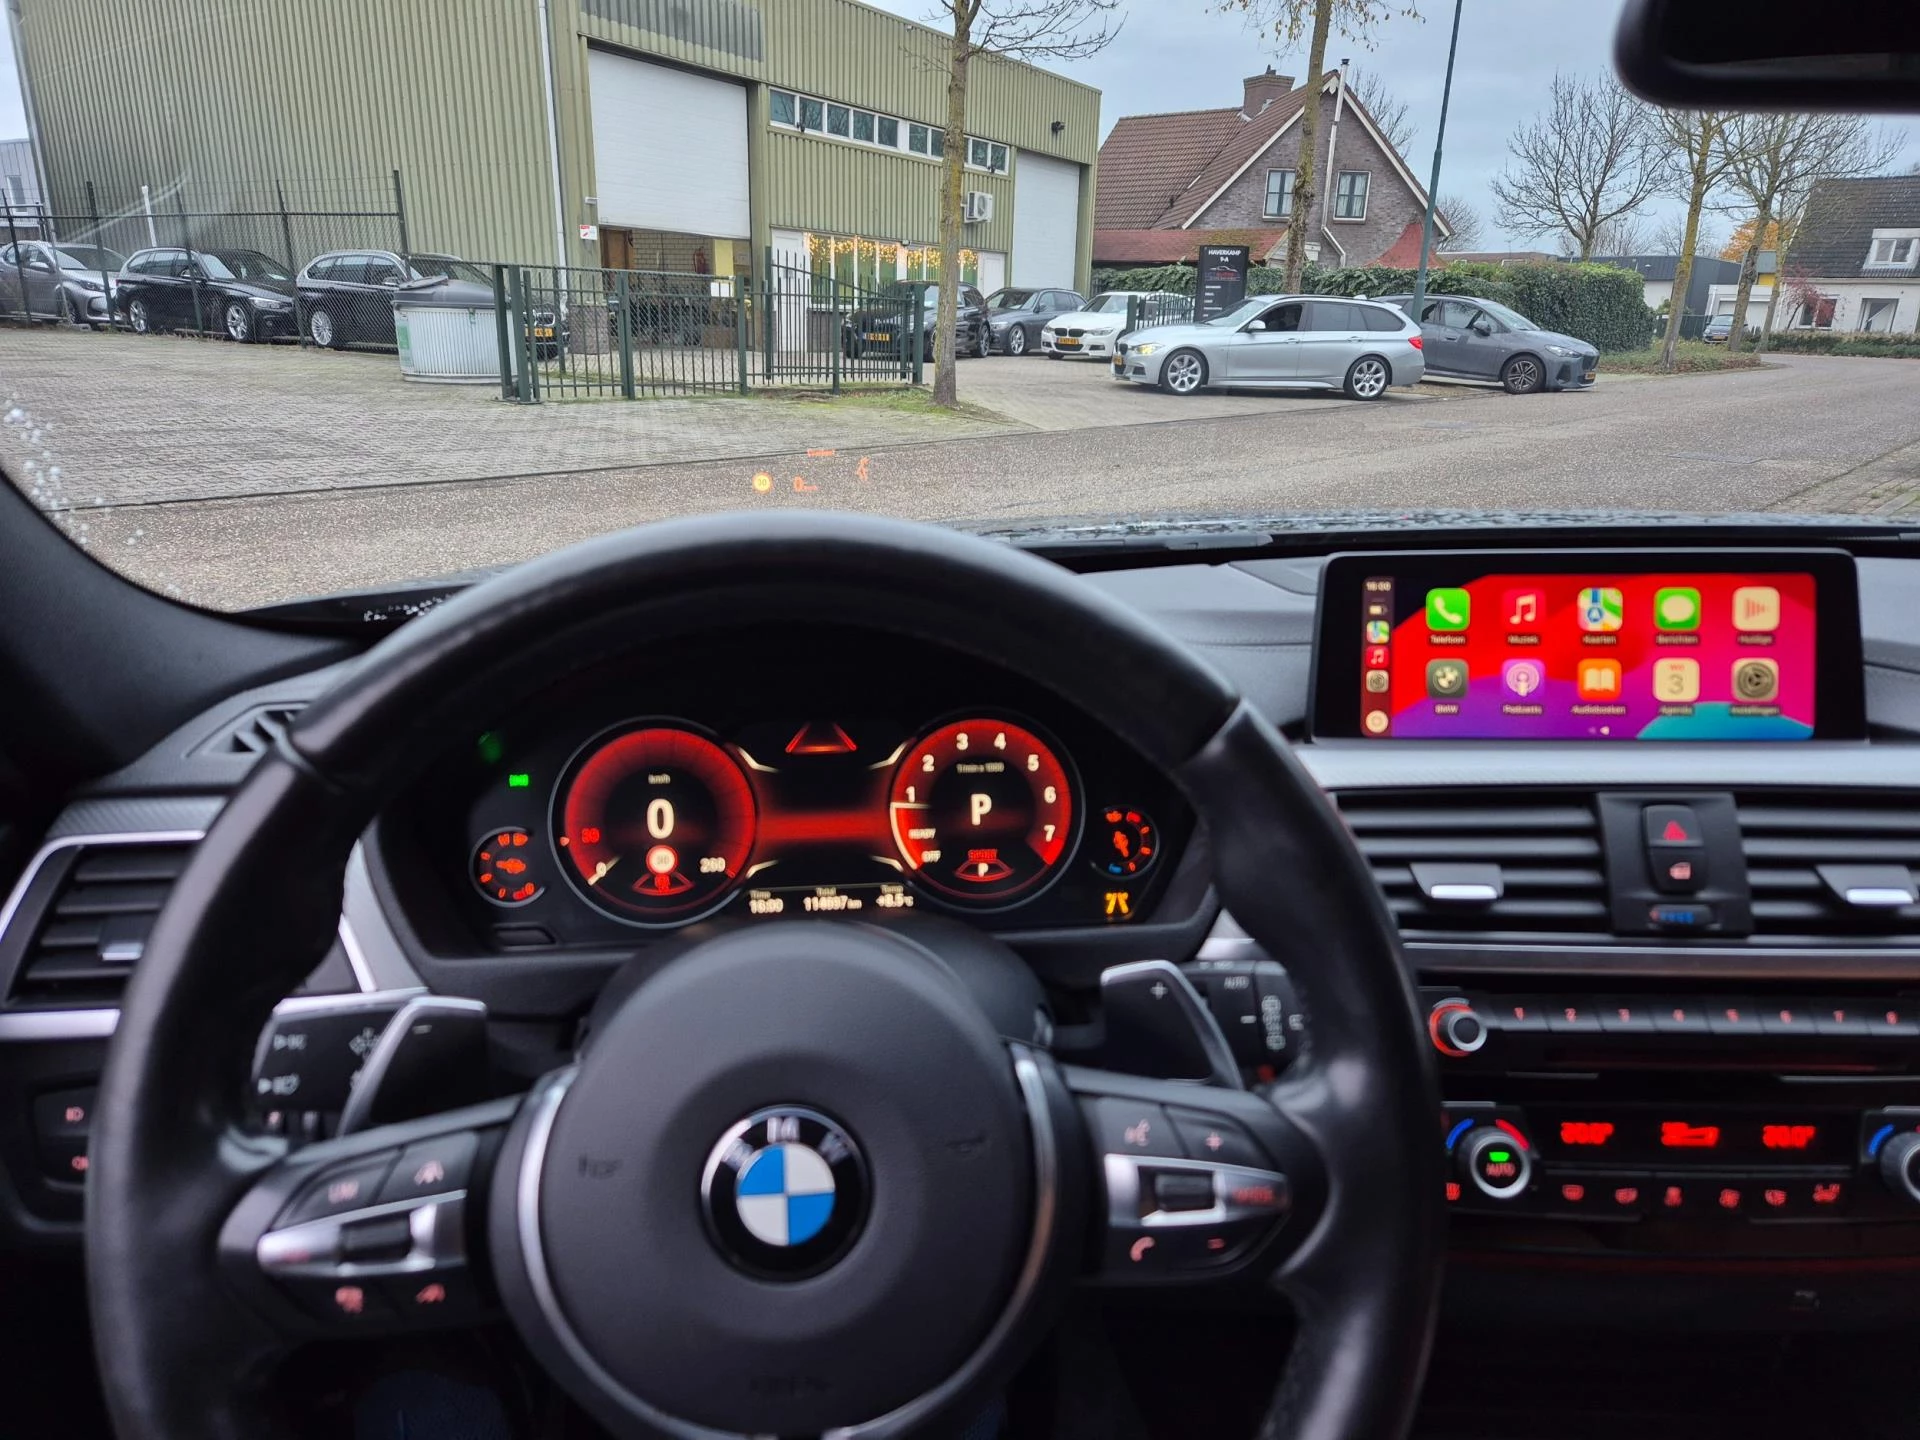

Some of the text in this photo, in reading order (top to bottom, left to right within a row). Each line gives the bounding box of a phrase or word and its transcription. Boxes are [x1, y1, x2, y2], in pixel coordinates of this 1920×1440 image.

[1429, 634, 1466, 645] Telefoon
[1507, 634, 1540, 645] Muziek
[1582, 634, 1617, 645] Kaarten
[1656, 634, 1698, 646] Berichten
[1668, 673, 1685, 695] 3
[1434, 704, 1459, 715] BMW
[1502, 704, 1542, 716] Podcasts
[956, 732, 968, 750] 3
[994, 732, 1006, 750] 4
[922, 754, 934, 772] 2
[1027, 754, 1040, 772] 5
[906, 786, 916, 803] 1
[1044, 786, 1056, 804] 6
[970, 793, 992, 826] P
[646, 798, 675, 840] 0
[908, 828, 936, 839] READY
[1043, 825, 1056, 842] 7
[921, 850, 942, 862] OFF
[968, 849, 998, 861] SPORT
[595, 861, 607, 877] 0
[978, 863, 989, 877] P
